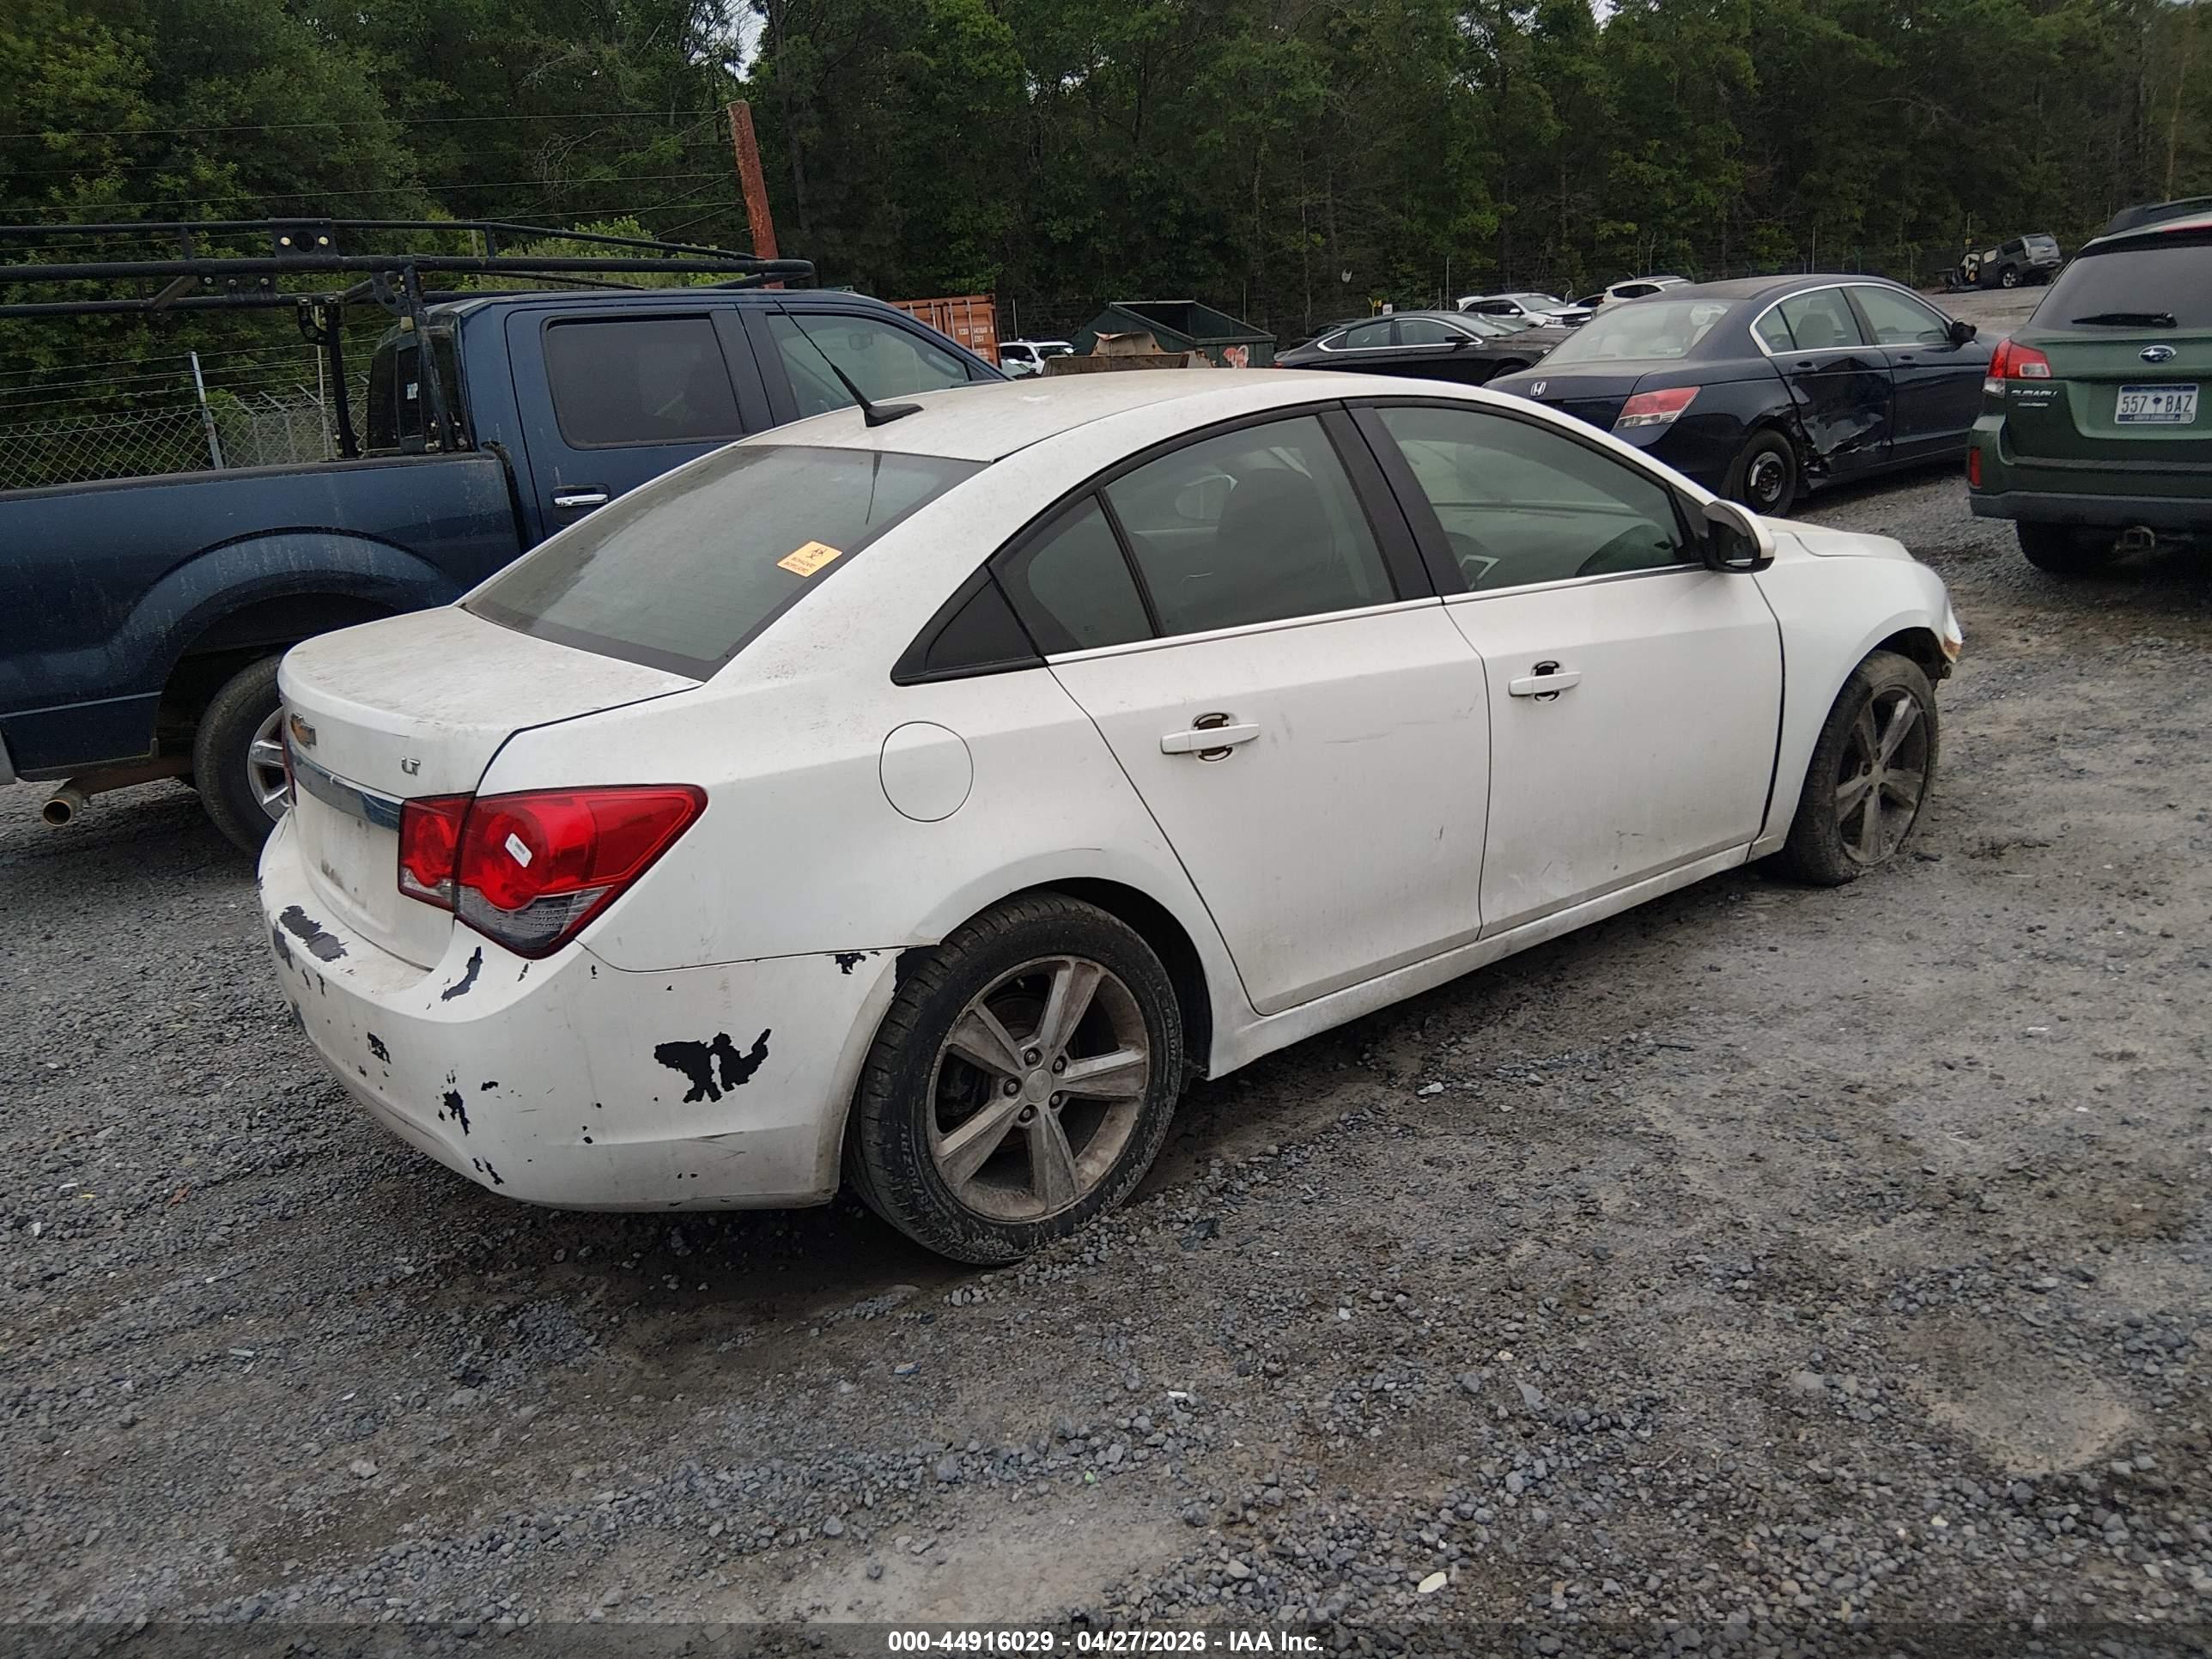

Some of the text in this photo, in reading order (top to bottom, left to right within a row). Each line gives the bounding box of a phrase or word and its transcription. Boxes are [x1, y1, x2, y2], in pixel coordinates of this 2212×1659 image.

[2122, 395, 2192, 413] 557 BAZ
[401, 757, 421, 776] LT
